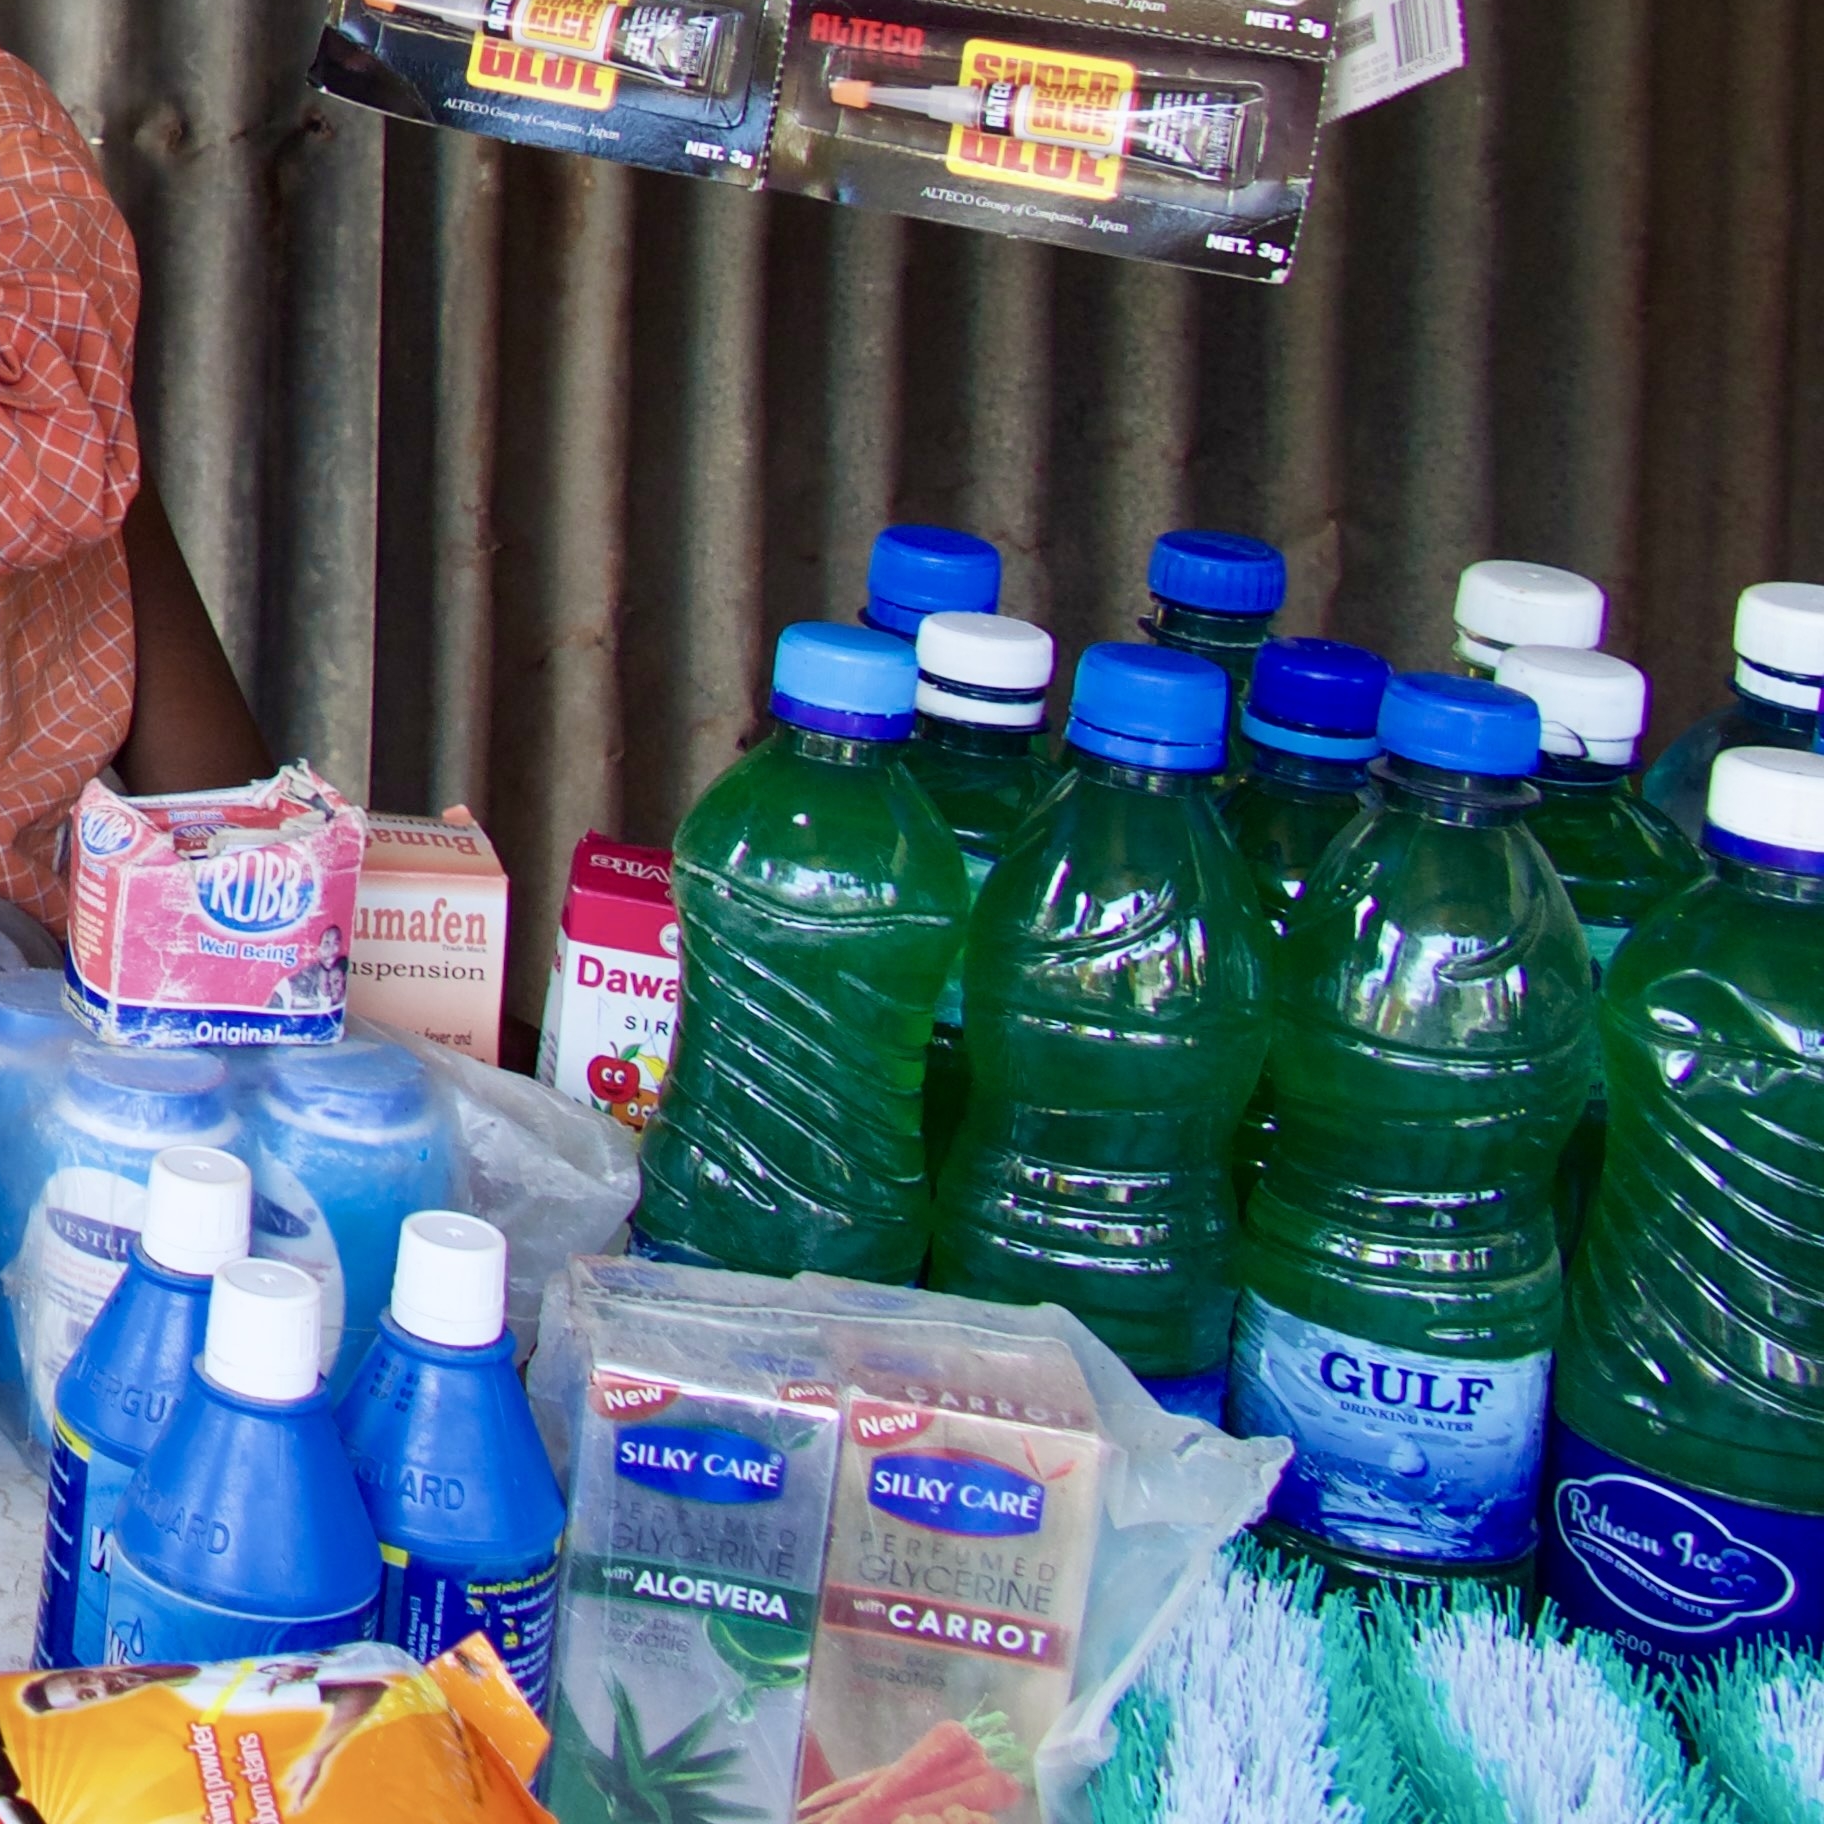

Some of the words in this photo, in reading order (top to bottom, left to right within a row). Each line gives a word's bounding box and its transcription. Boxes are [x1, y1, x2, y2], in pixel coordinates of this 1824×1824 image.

[810, 12, 926, 57] ALTECO
[1245, 10, 1292, 33] NET.
[1295, 14, 1327, 40] 3g
[684, 139, 726, 161] NET.
[729, 146, 754, 169] 3g
[1205, 232, 1253, 257] NET.
[1256, 239, 1287, 265] 3g
[208, 850, 303, 924] ROBB
[353, 897, 488, 946] umafen
[198, 934, 237, 958] Well
[242, 942, 298, 968] Being
[349, 960, 485, 983] uspension
[195, 1020, 281, 1044] Original
[604, 1385, 664, 1411] New
[1318, 1350, 1494, 1417] GULF
[857, 1411, 919, 1439] New
[1338, 1398, 1420, 1430] DRINKING
[1422, 1417, 1475, 1435] WATER
[620, 1440, 698, 1473] SILKY
[703, 1453, 780, 1488] CARE
[873, 1469, 955, 1504] SILKY
[958, 1483, 1039, 1521] CARE
[610, 1521, 797, 1581] GLYCERINE
[859, 1530, 1056, 1583] PERFUMED
[632, 1569, 792, 1623] ALOEVERA
[857, 1552, 1054, 1616] GLYCERINE
[888, 1602, 1049, 1657] CARROT
[1614, 1628, 1652, 1658] 500
[1657, 1648, 1685, 1669] ml
